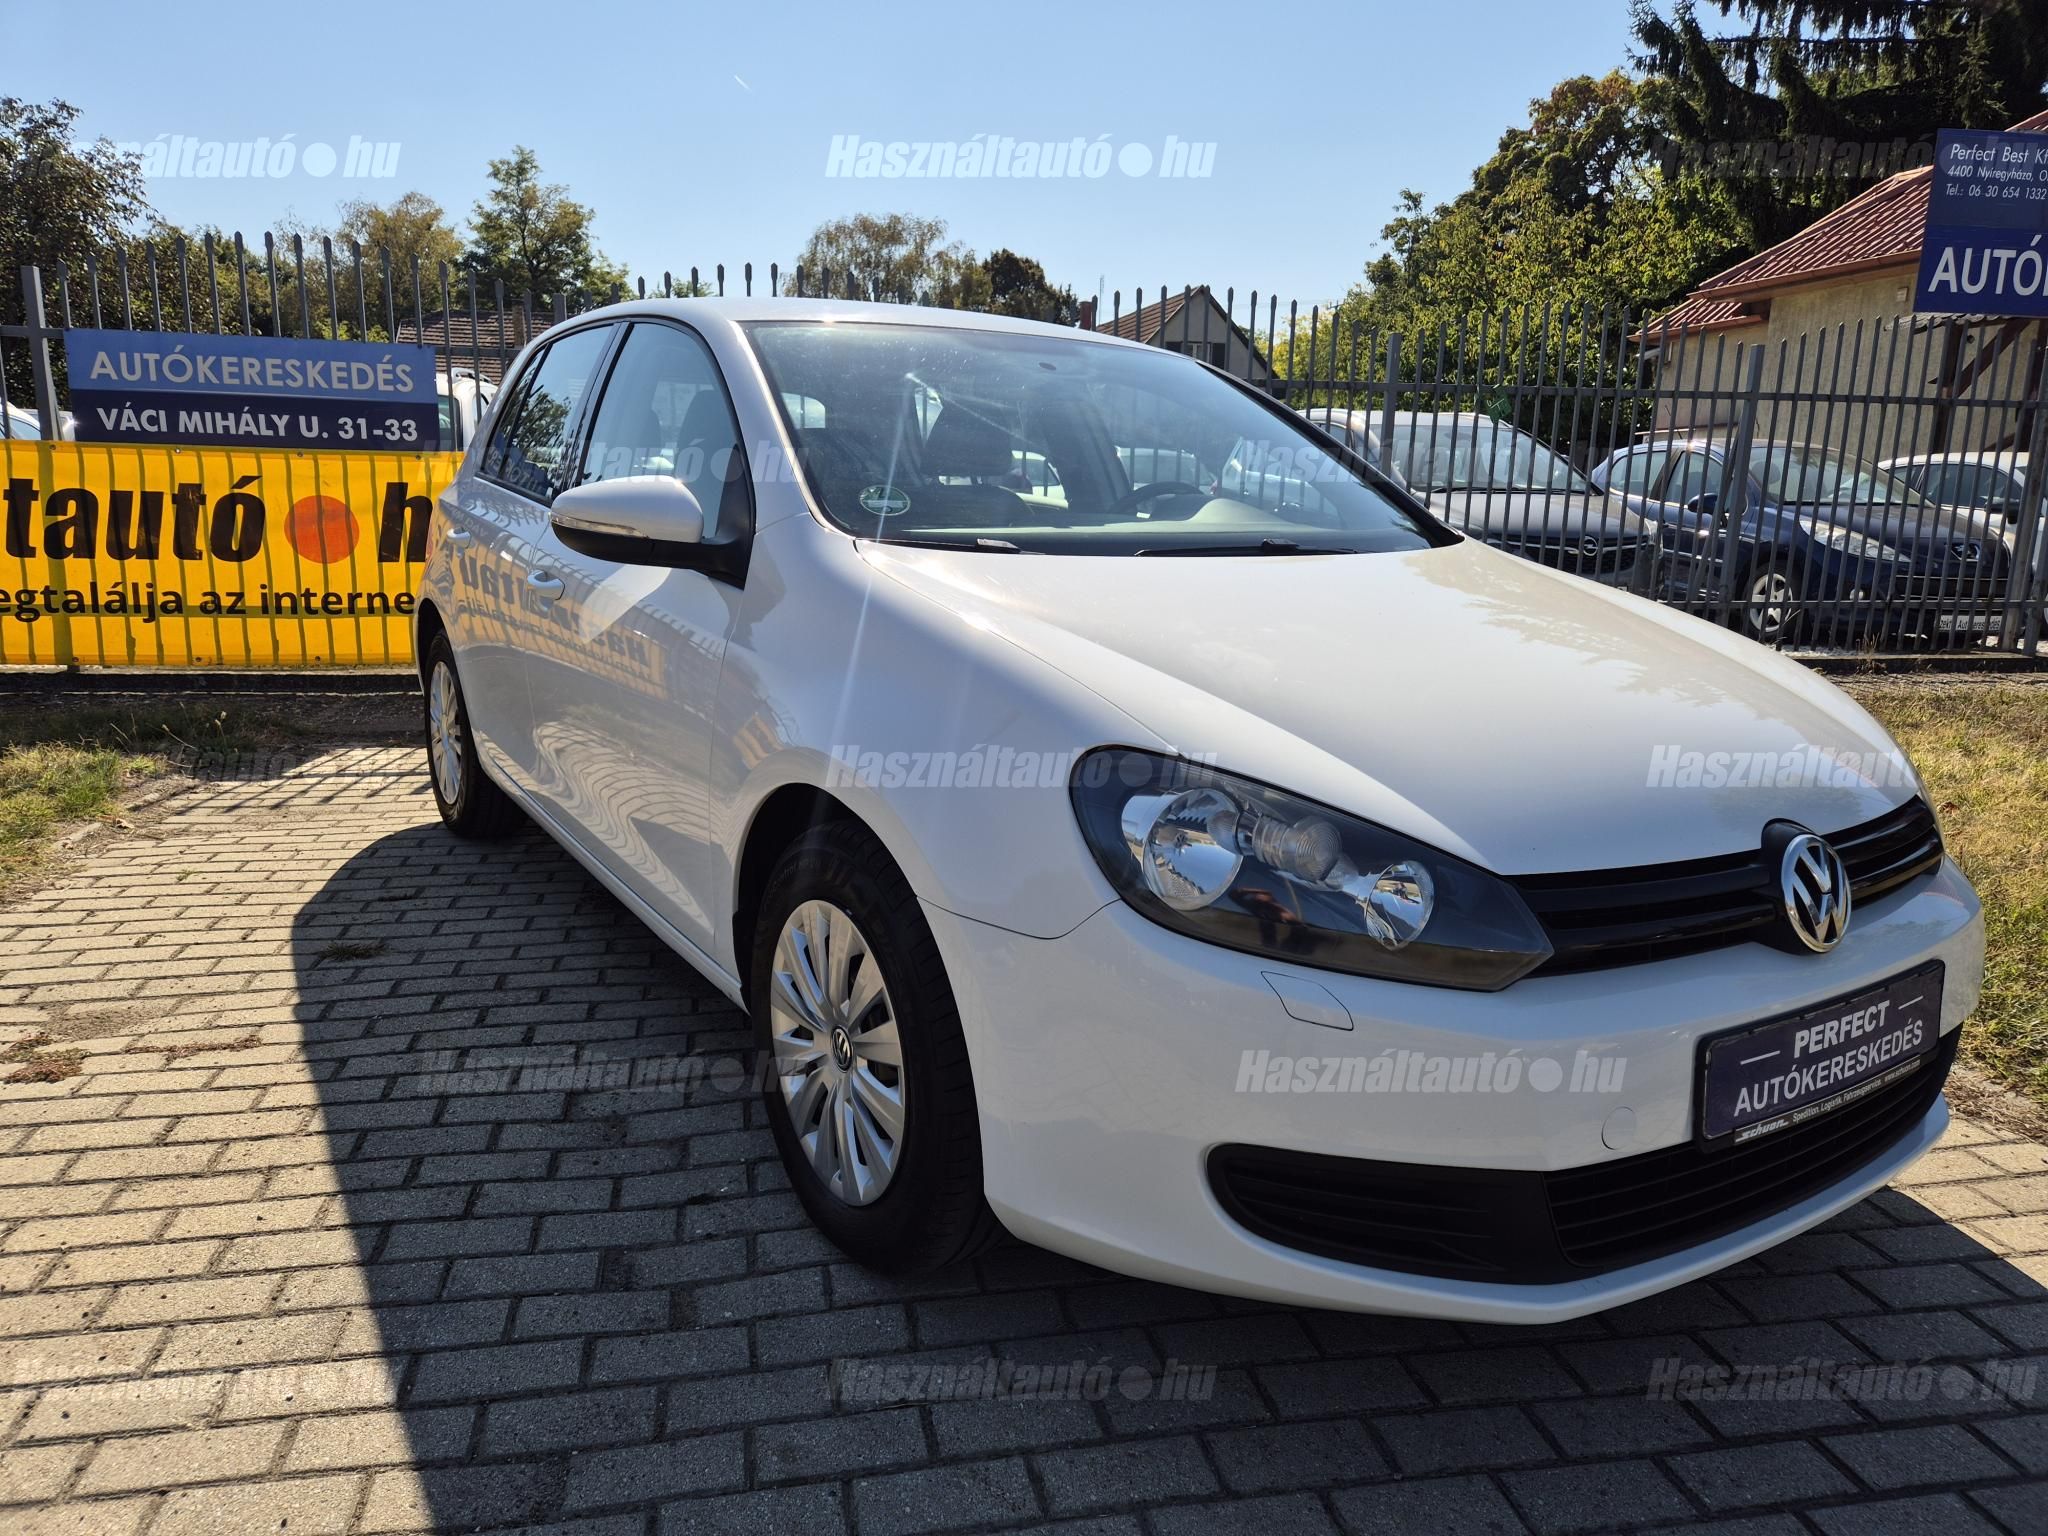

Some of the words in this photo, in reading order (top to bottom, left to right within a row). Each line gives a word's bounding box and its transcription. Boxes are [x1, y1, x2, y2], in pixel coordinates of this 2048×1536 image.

[1947, 165, 1974, 178] 4400
[1949, 143, 1996, 162] Perfect
[2001, 146, 2029, 163] Best
[1968, 184, 1982, 197] 06
[1985, 185, 1999, 198] 30
[2002, 186, 2020, 199] 654
[2025, 187, 2047, 200] 1332
[1928, 234, 2048, 297] AUTÓ
[90, 345, 414, 393] AUTÓKERESKEDÉS
[97, 402, 168, 432] VÁCI
[178, 407, 290, 437] MIHÁLY
[300, 415, 329, 439] U.
[337, 417, 418, 442] 31-33
[199, 590, 247, 615] az
[1794, 1000, 1890, 1059] PERFECT
[1733, 1017, 1924, 1118] AUTÓKERESKEDÉS
